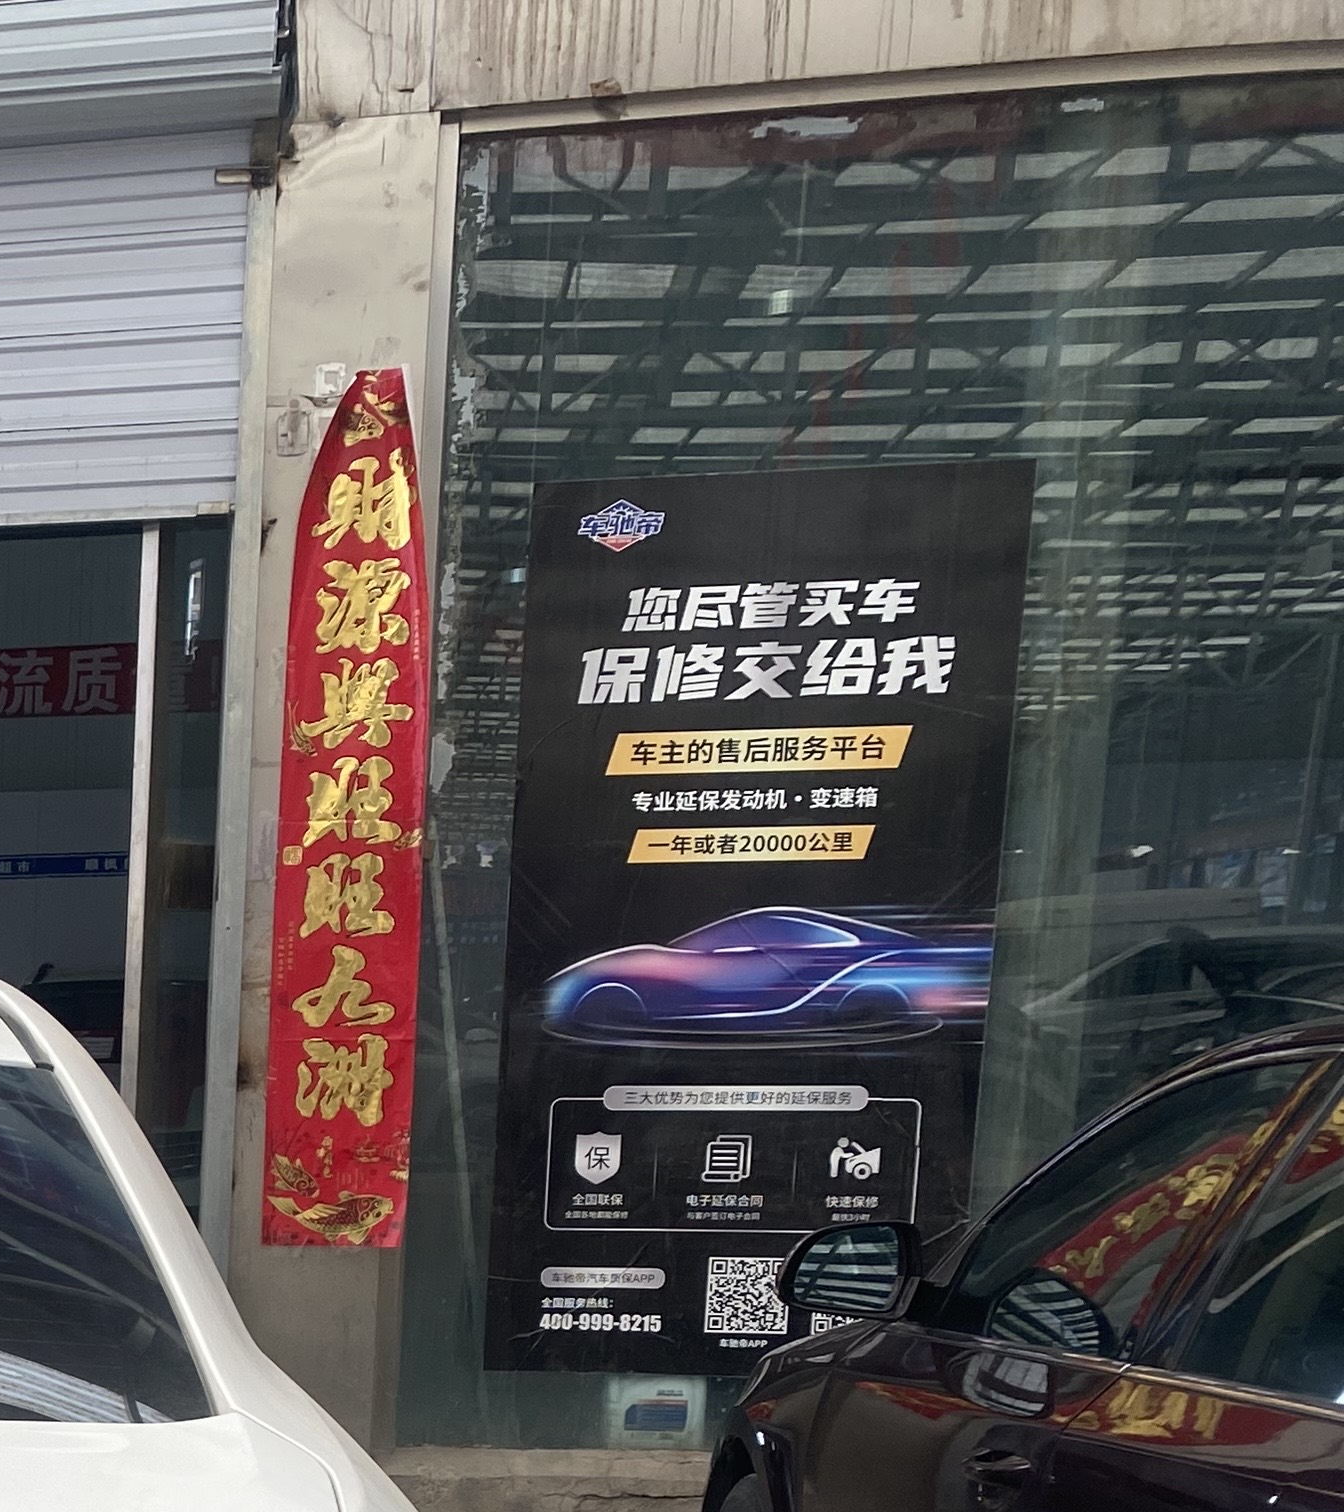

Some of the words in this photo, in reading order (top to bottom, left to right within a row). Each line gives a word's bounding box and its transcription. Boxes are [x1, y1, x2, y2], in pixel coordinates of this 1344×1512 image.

[621, 578, 920, 632] 您尽管买车
[577, 635, 956, 705] 保修交给我
[630, 734, 887, 766] 车主的售后服务平台
[648, 832, 854, 856] 一年或者20000公里
[624, 1090, 852, 1106] 三大优势为您提供更好的延保服务
[584, 1145, 611, 1171] 保
[572, 1193, 624, 1207] 全国联保
[686, 1194, 764, 1208] 电子延保合同
[825, 1195, 879, 1209] 快速保修
[551, 1273, 656, 1284] 车驰帝汽车质保APP
[539, 1314, 662, 1333] 400-999-8215
